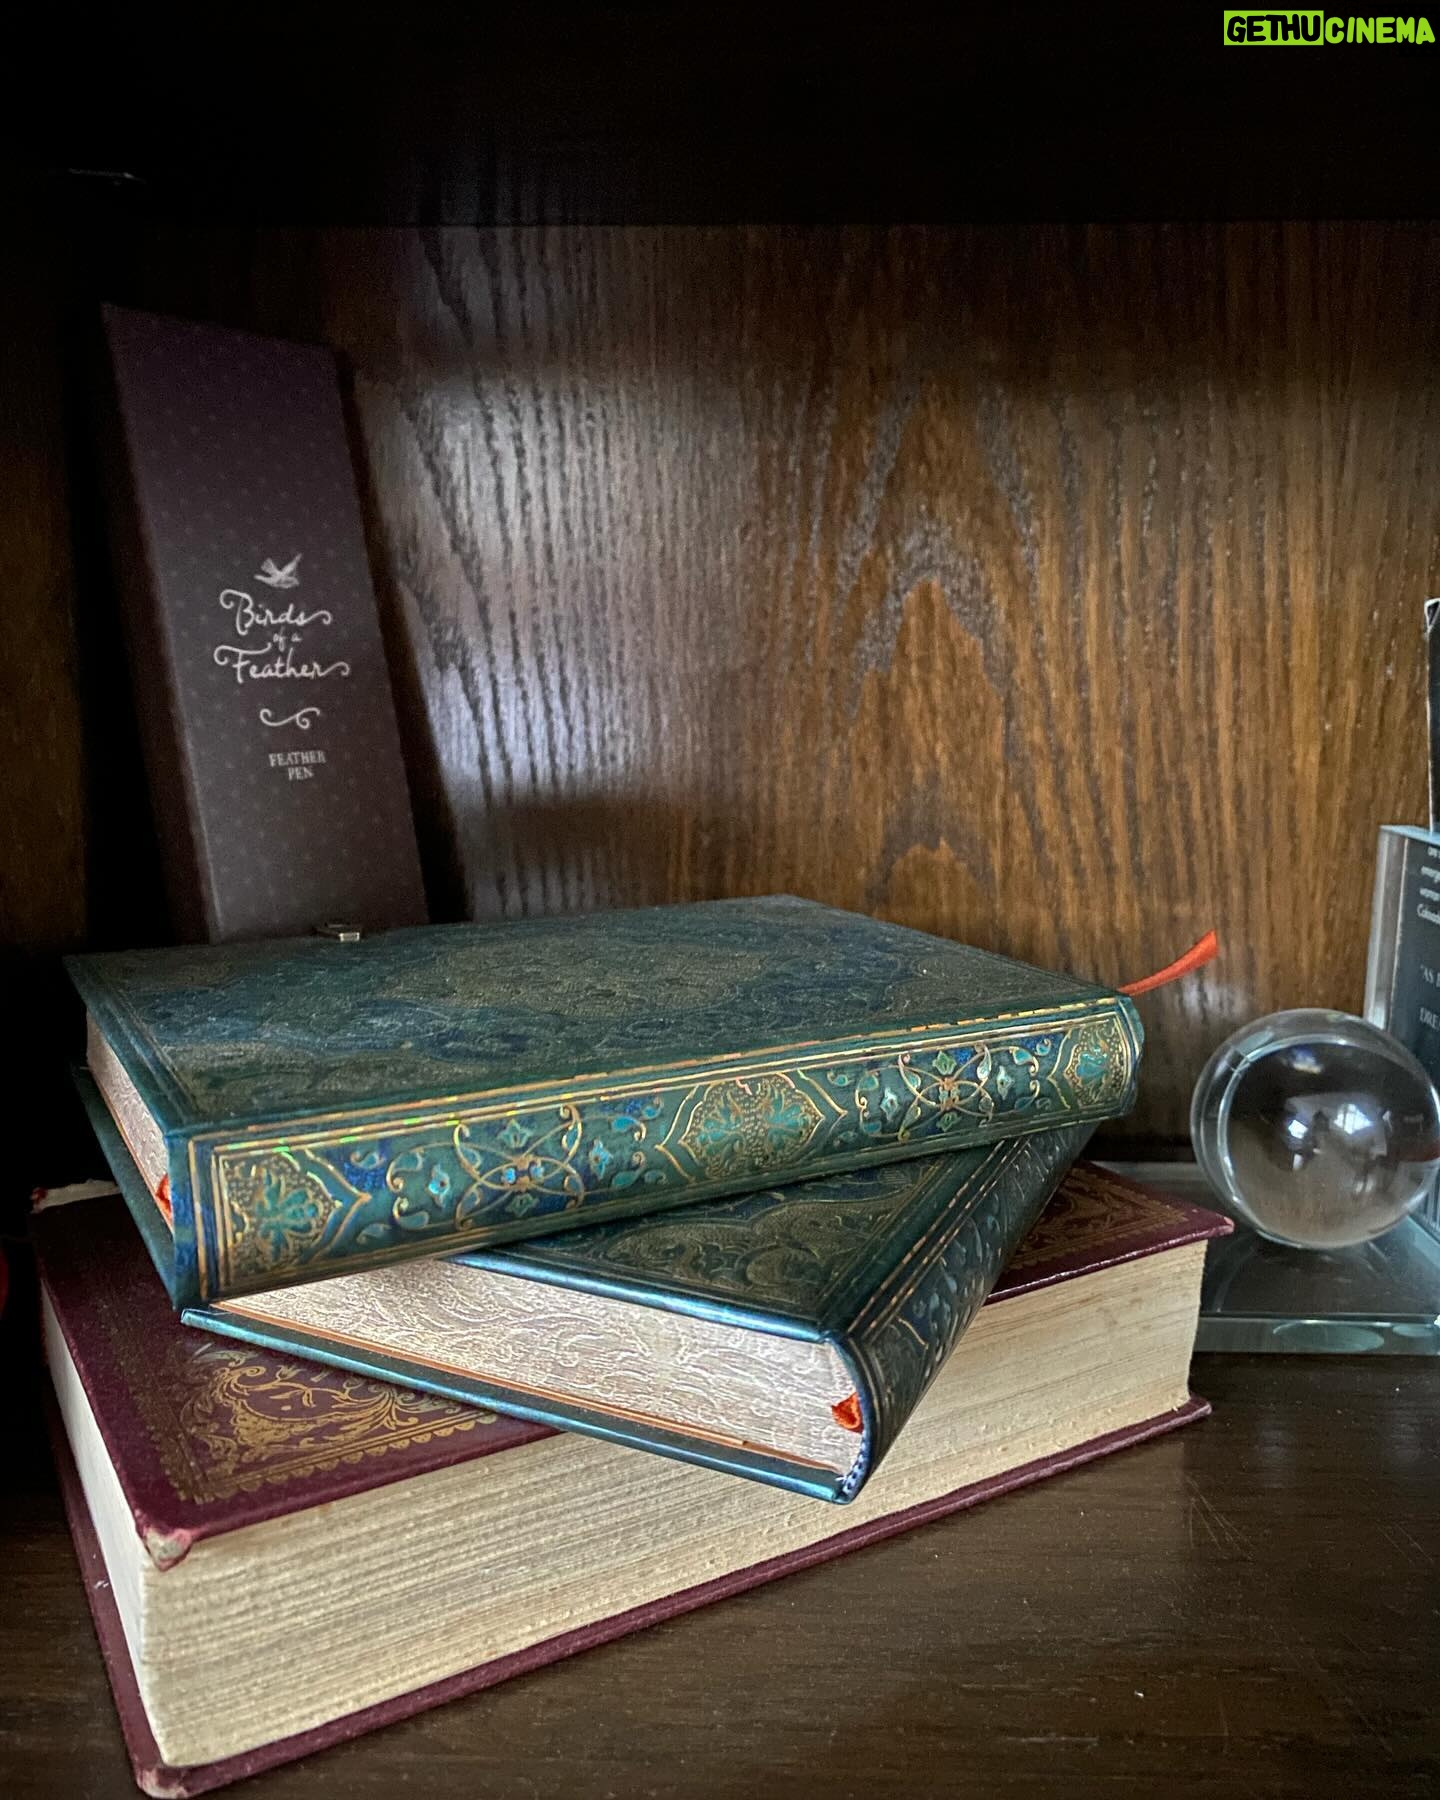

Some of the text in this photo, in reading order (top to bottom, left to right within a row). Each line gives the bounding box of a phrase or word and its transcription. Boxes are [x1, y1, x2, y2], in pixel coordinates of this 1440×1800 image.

[219, 588, 332, 635] Birds
[273, 627, 302, 651] of a
[213, 642, 350, 684] Feather
[268, 750, 326, 767] FEATHER
[288, 766, 314, 781] PEN
